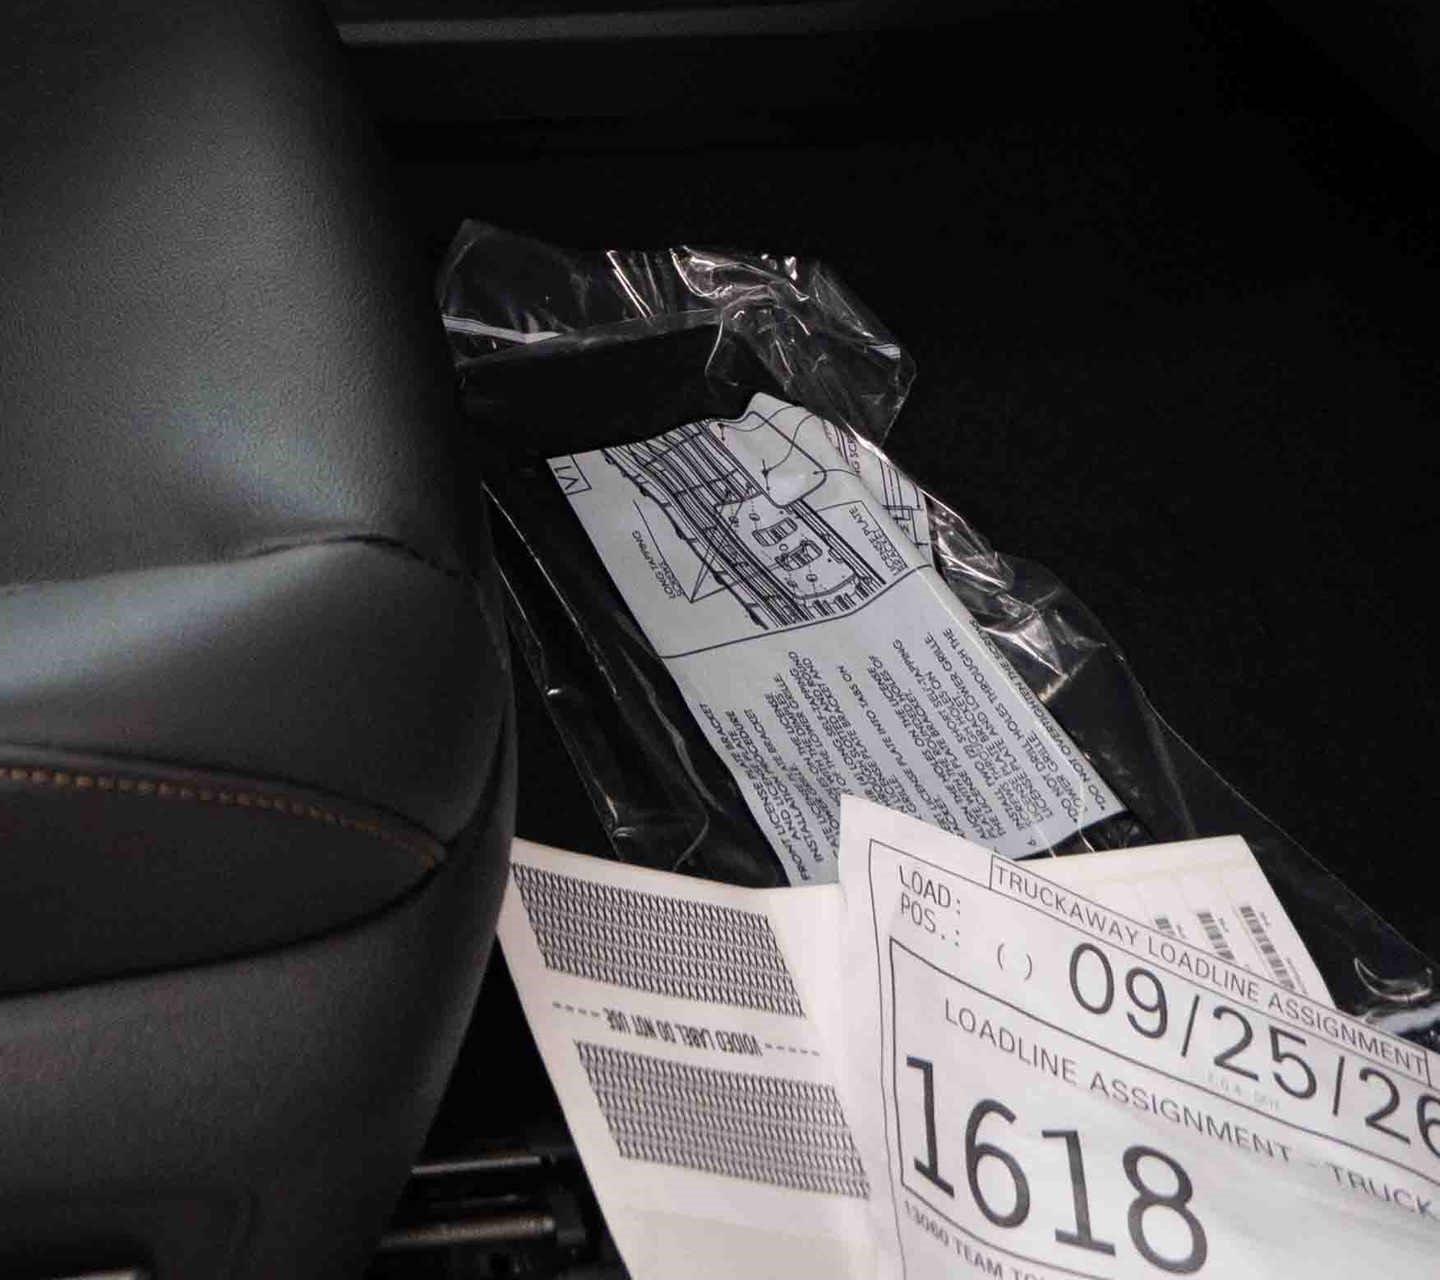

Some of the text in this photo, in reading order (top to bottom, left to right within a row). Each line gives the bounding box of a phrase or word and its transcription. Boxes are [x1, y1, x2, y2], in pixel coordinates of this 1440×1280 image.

[553, 466, 579, 490] V1
[847, 504, 872, 536] PLATE
[941, 626, 962, 650] THE
[786, 648, 815, 689] ROUND
[800, 655, 821, 682] AND
[836, 664, 853, 684] ON
[879, 668, 906, 703] HOLES
[891, 637, 943, 709] SELF-TAPPING
[924, 669, 942, 691] ON
[955, 646, 999, 704] THROUGH
[764, 690, 795, 736] LICENSE
[810, 686, 832, 715] AND
[816, 679, 851, 730] BRACKET
[847, 682, 869, 709] TABS
[938, 689, 966, 725] HOLES
[697, 700, 735, 752] BRACKET
[742, 705, 778, 755] BRACKET
[864, 707, 887, 737] INTO
[900, 700, 942, 758] ROUNDED
[921, 630, 1054, 819] LICENSE PLATE AND LOWER GRILLE.
[937, 706, 966, 744] SHORT
[993, 701, 1025, 741] HOLES
[1011, 679, 1071, 757] OVERTIGHTEN
[831, 736, 857, 771] LONG
[865, 663, 989, 842] ALIGN THE HOLES ON THE LICENSE
[881, 734, 908, 768] PLATE
[935, 736, 961, 770] PLATE
[961, 724, 1002, 781] THROUGH
[985, 742, 1012, 776] PLATE
[1018, 737, 1047, 773] DRILL
[1066, 756, 1090, 784] NOT
[902, 764, 937, 812] LICENSE
[972, 758, 996, 788] TWO
[1041, 770, 1064, 797] NOT
[752, 779, 787, 836] LICENSE
[769, 774, 825, 864] INSTALLATION
[992, 786, 1026, 832] INSTALL
[1008, 775, 1044, 823] LICENSE
[778, 807, 802, 843] AND
[987, 813, 1007, 837] THE
[780, 835, 811, 881] FRONT
[899, 865, 961, 914] LOAD:
[994, 864, 1138, 947] TRUCKAWAY
[1148, 935, 1260, 1004] LOADLINE
[1268, 992, 1426, 1075] ASSIGNMENT
[603, 1007, 763, 1056] VOIDED LABEL DO NOT USE
[944, 998, 1077, 1086] LOADLINE
[1089, 1070, 1293, 1164] ASSIGNMENT
[1330, 1165, 1440, 1222] TRUCK
[906, 1055, 1208, 1275] 1618
[904, 1199, 950, 1247] 13060
[952, 1238, 1003, 1279] TEAM
